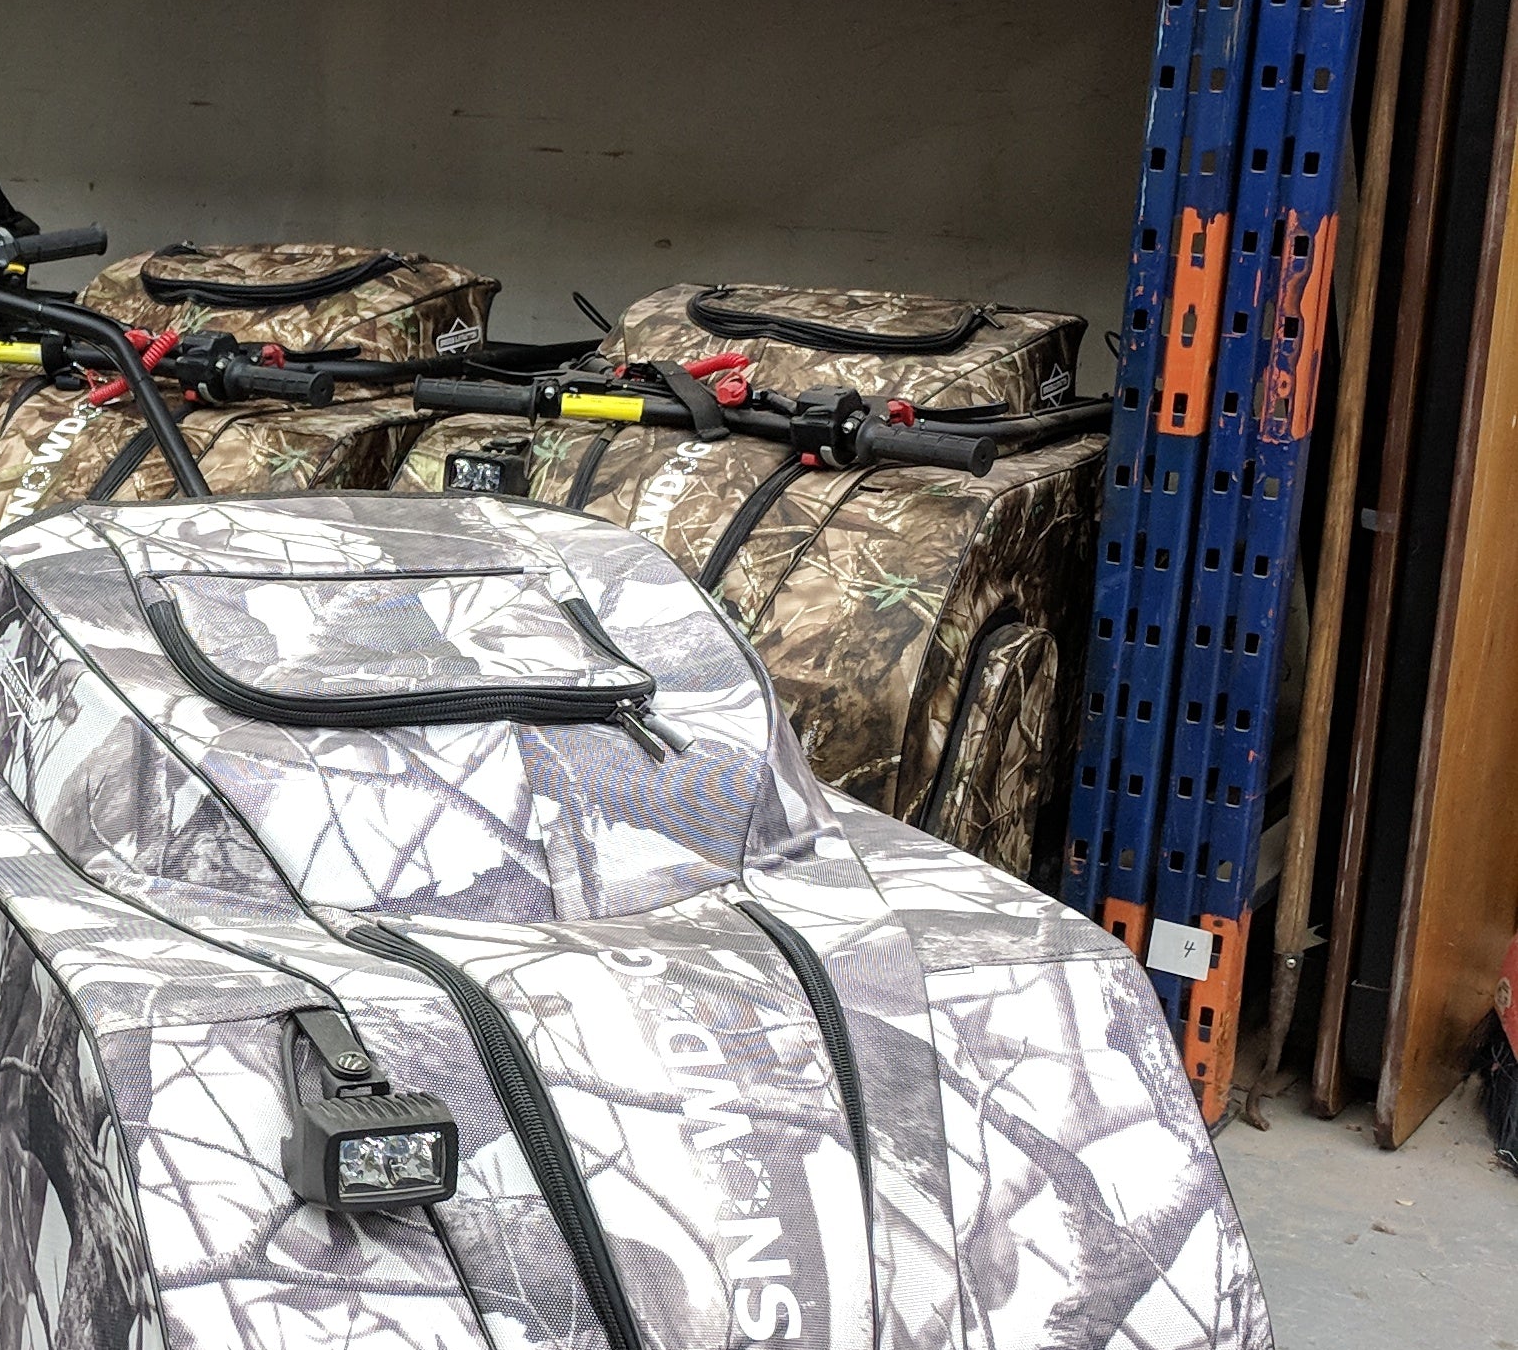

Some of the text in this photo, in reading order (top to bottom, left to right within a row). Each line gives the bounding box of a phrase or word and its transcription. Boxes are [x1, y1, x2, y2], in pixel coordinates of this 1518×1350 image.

[6, 401, 102, 517] NOWDO
[629, 441, 713, 532] WDOG
[1183, 940, 1197, 959] 4
[597, 949, 803, 1342] SNOWDOG
